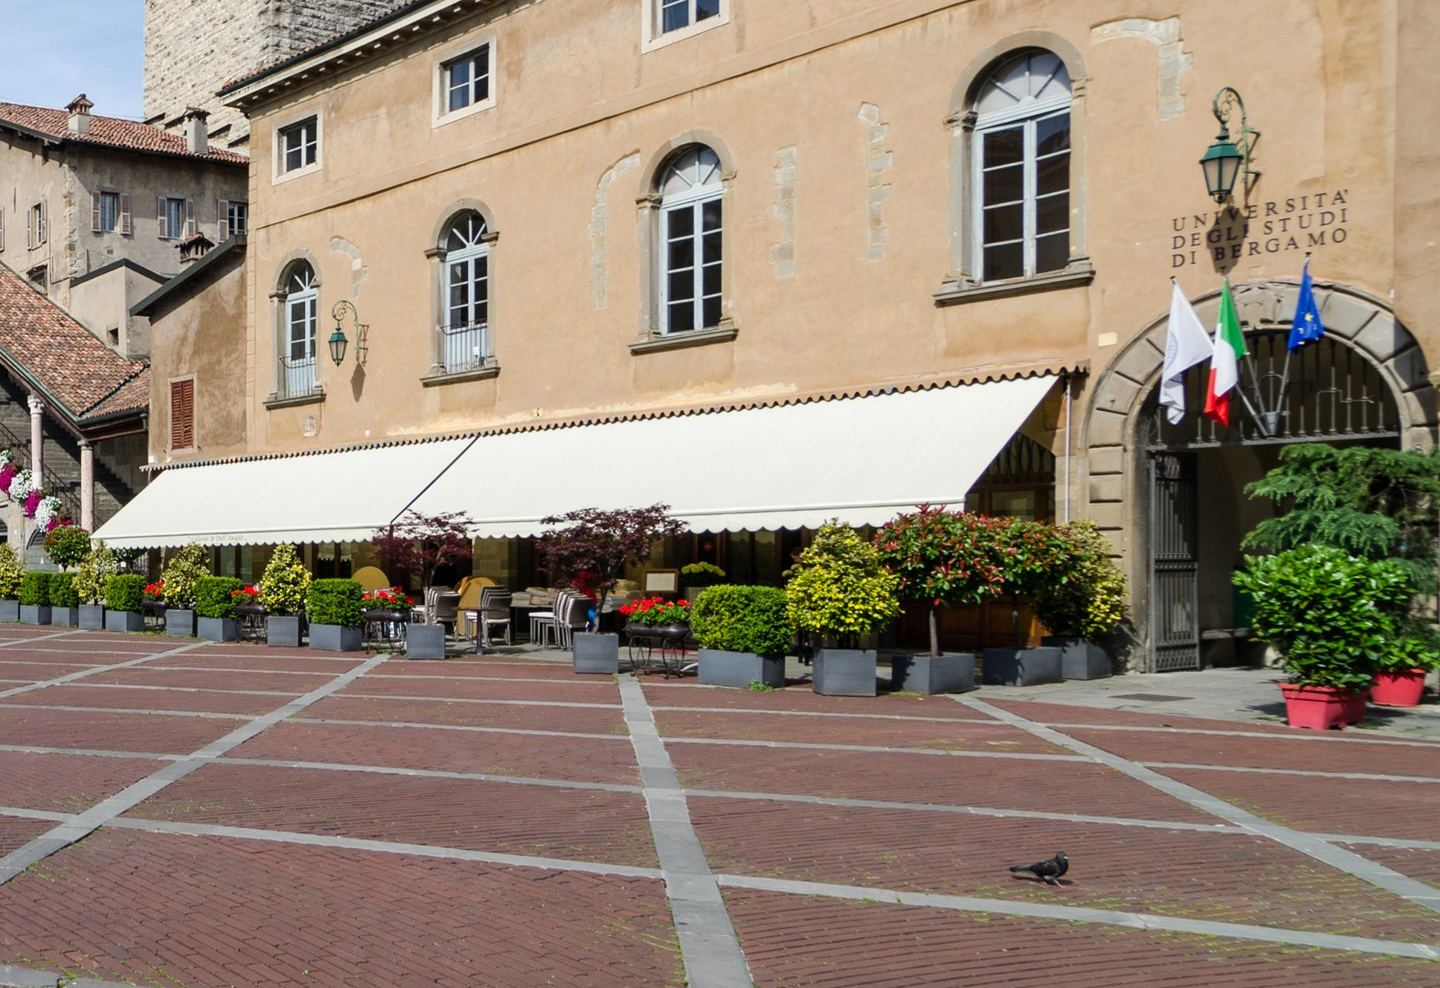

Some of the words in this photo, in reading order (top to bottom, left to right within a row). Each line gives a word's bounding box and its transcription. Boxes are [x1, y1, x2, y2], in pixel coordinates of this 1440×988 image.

[1171, 251, 1197, 268] DI
[1214, 228, 1348, 262] BERGAMO
[1172, 224, 1249, 250] DEGLI
[1263, 208, 1348, 236] STUDI
